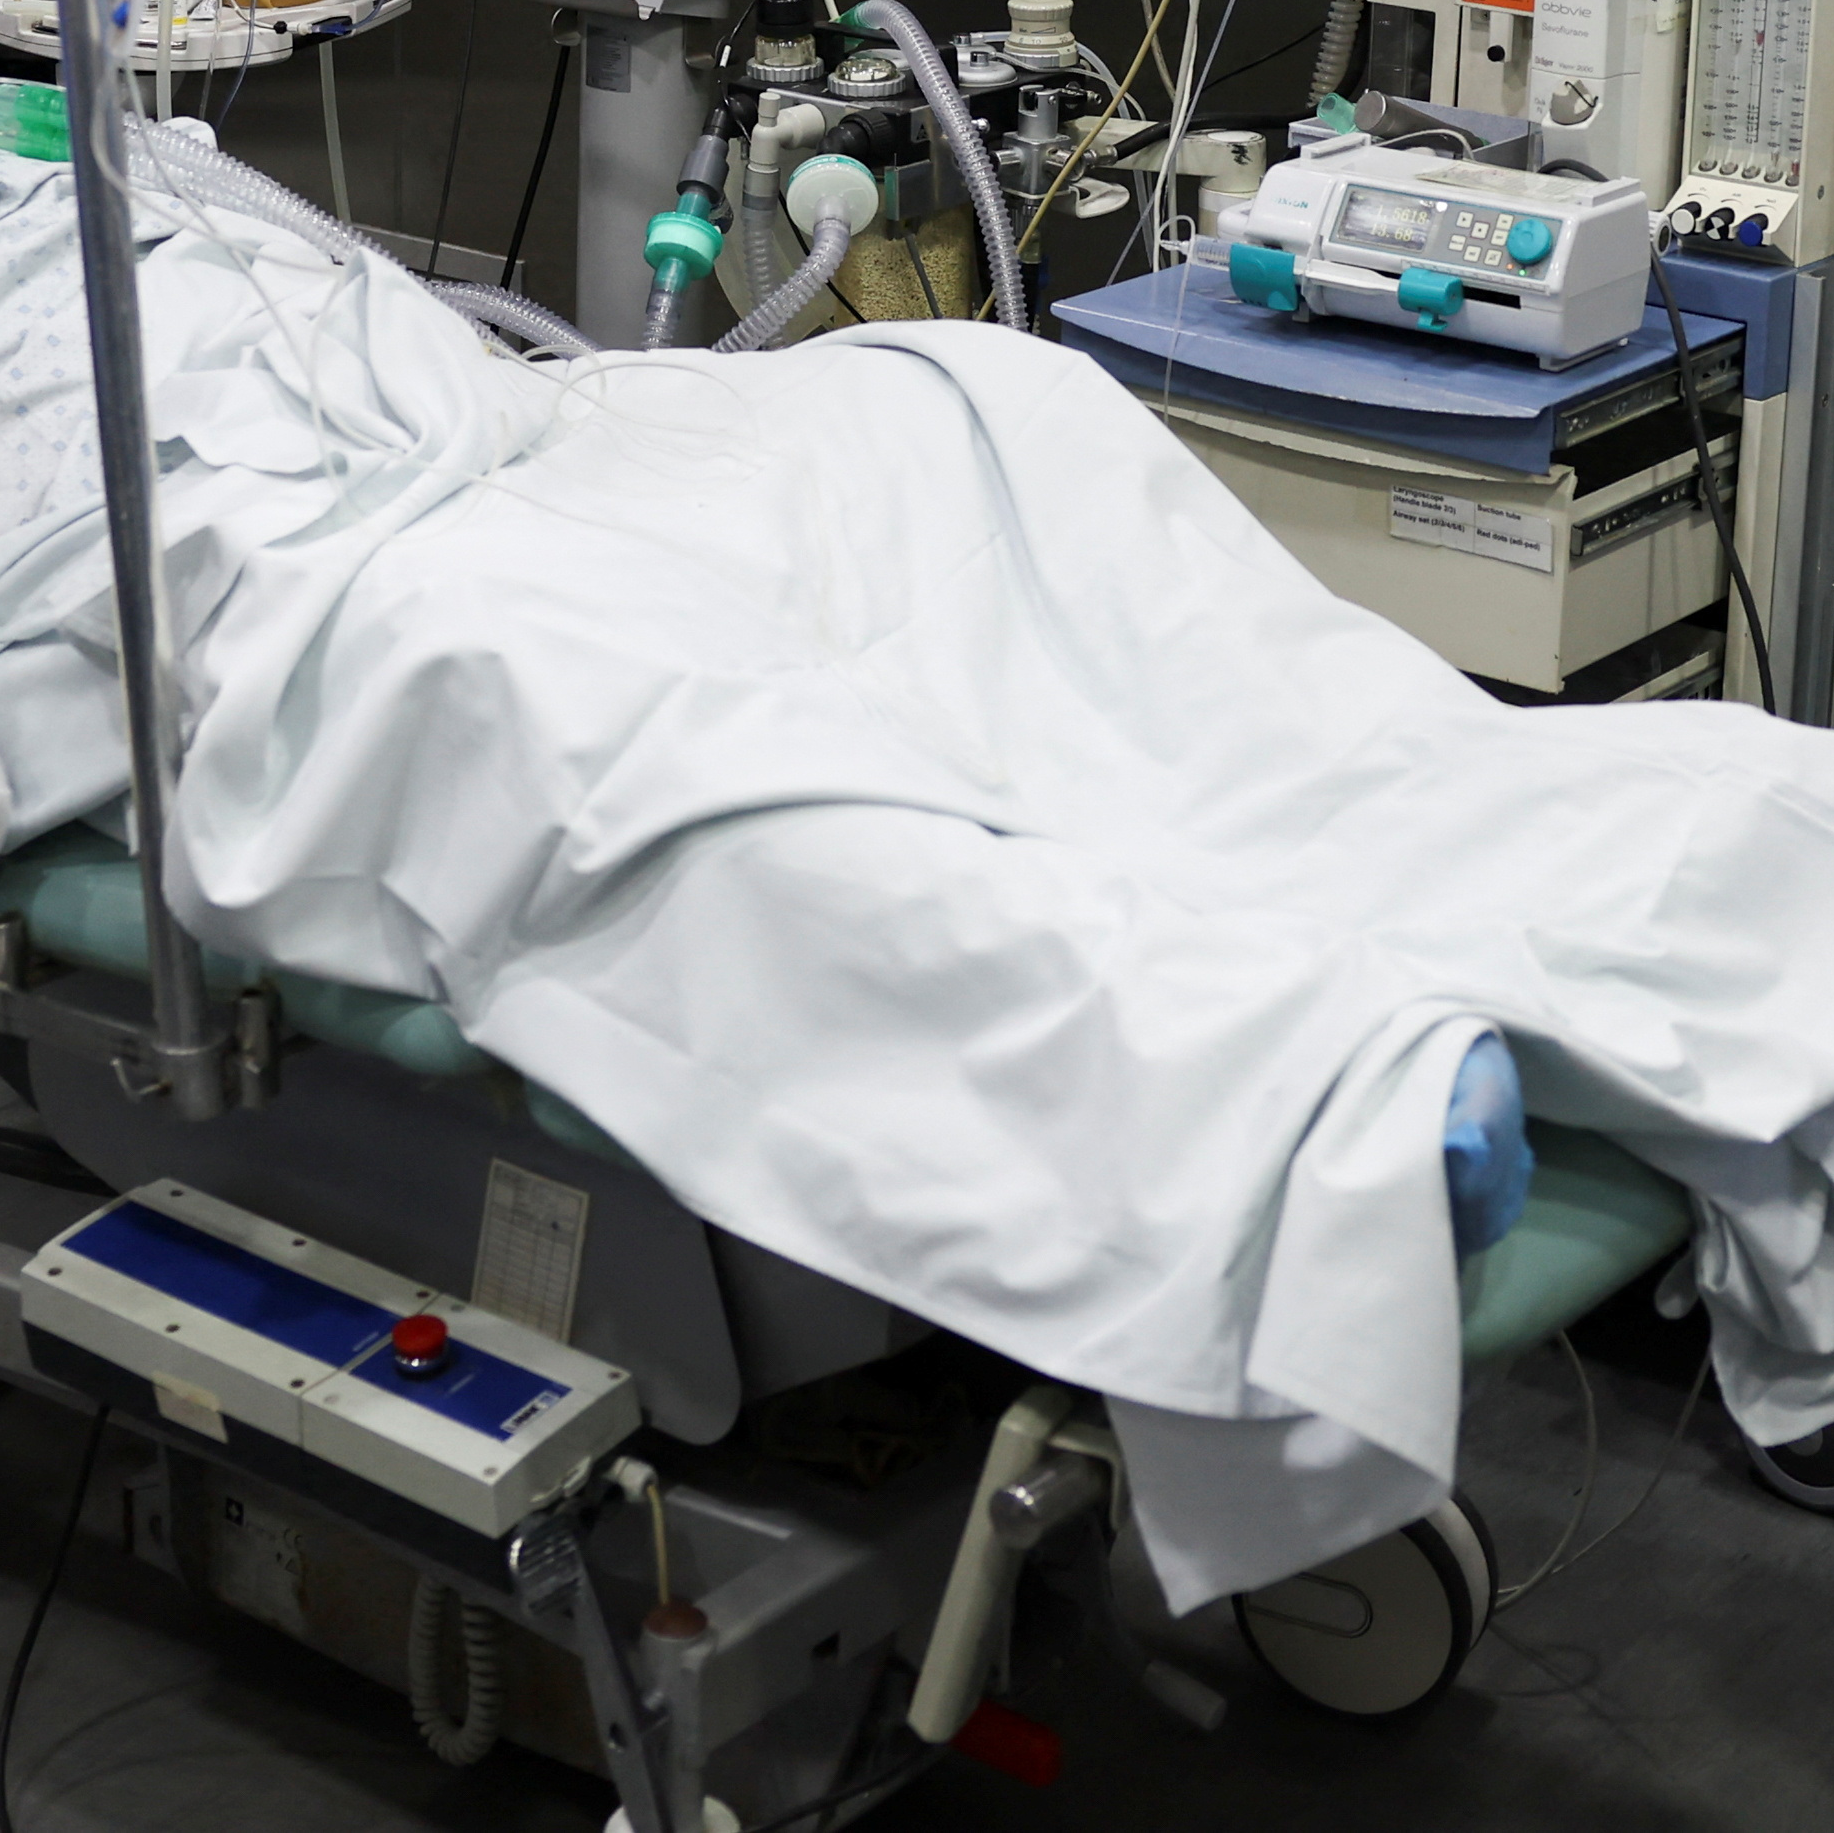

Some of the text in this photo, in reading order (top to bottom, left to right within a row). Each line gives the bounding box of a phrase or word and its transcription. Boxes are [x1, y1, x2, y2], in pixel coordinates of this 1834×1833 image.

[1541, 3, 1592, 17] abbvie
[1541, 22, 1589, 38] Sevoflurane
[1534, 56, 1554, 67] Dräger
[1393, 486, 1444, 502] Laryngoscope
[1393, 495, 1420, 507] (Handle
[1421, 501, 1442, 511] blade
[1393, 510, 1417, 523] Airway
[1418, 516, 1430, 524] set
[1477, 504, 1521, 520] Suction tube
[1477, 528, 1491, 538] Red
[1492, 533, 1508, 543] dots
